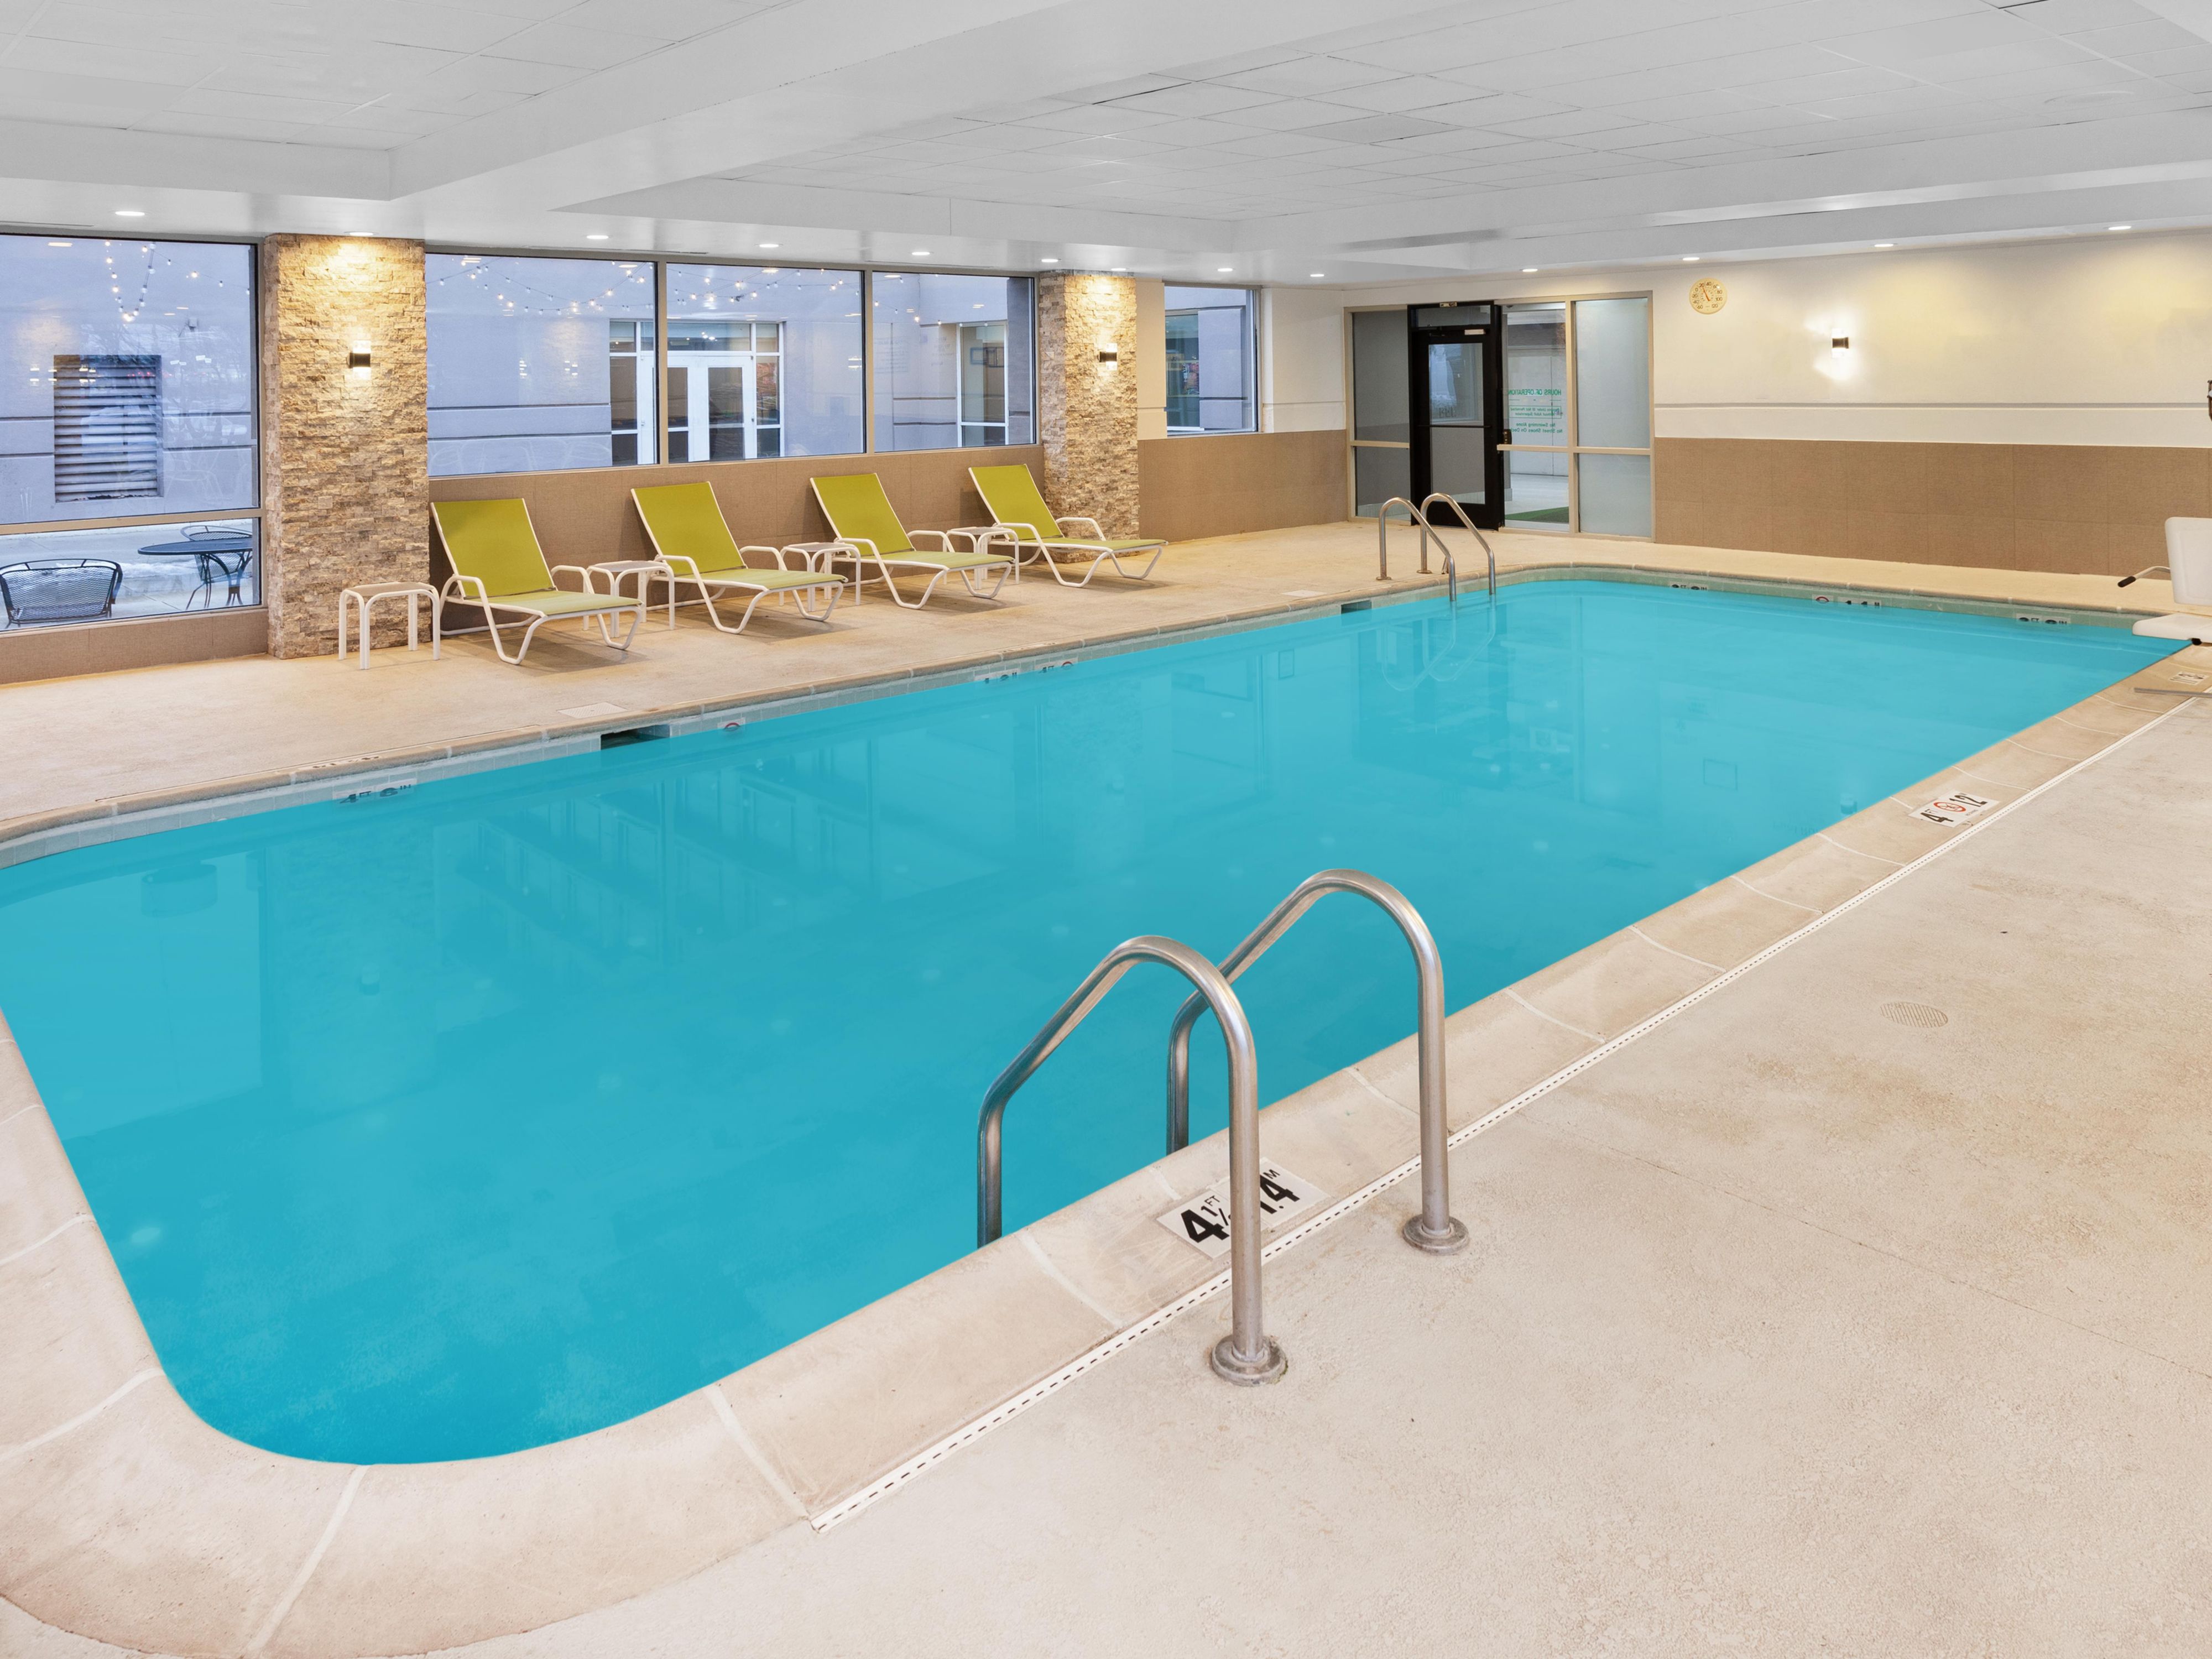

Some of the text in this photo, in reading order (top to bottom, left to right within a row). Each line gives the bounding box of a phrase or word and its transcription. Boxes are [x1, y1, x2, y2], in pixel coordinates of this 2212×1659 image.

[1949, 795, 1988, 807] 12
[1920, 812, 1954, 823] 4
[1262, 1169, 1281, 1180] M
[1204, 1195, 1220, 1207] FT
[1181, 1209, 1230, 1243] 4
